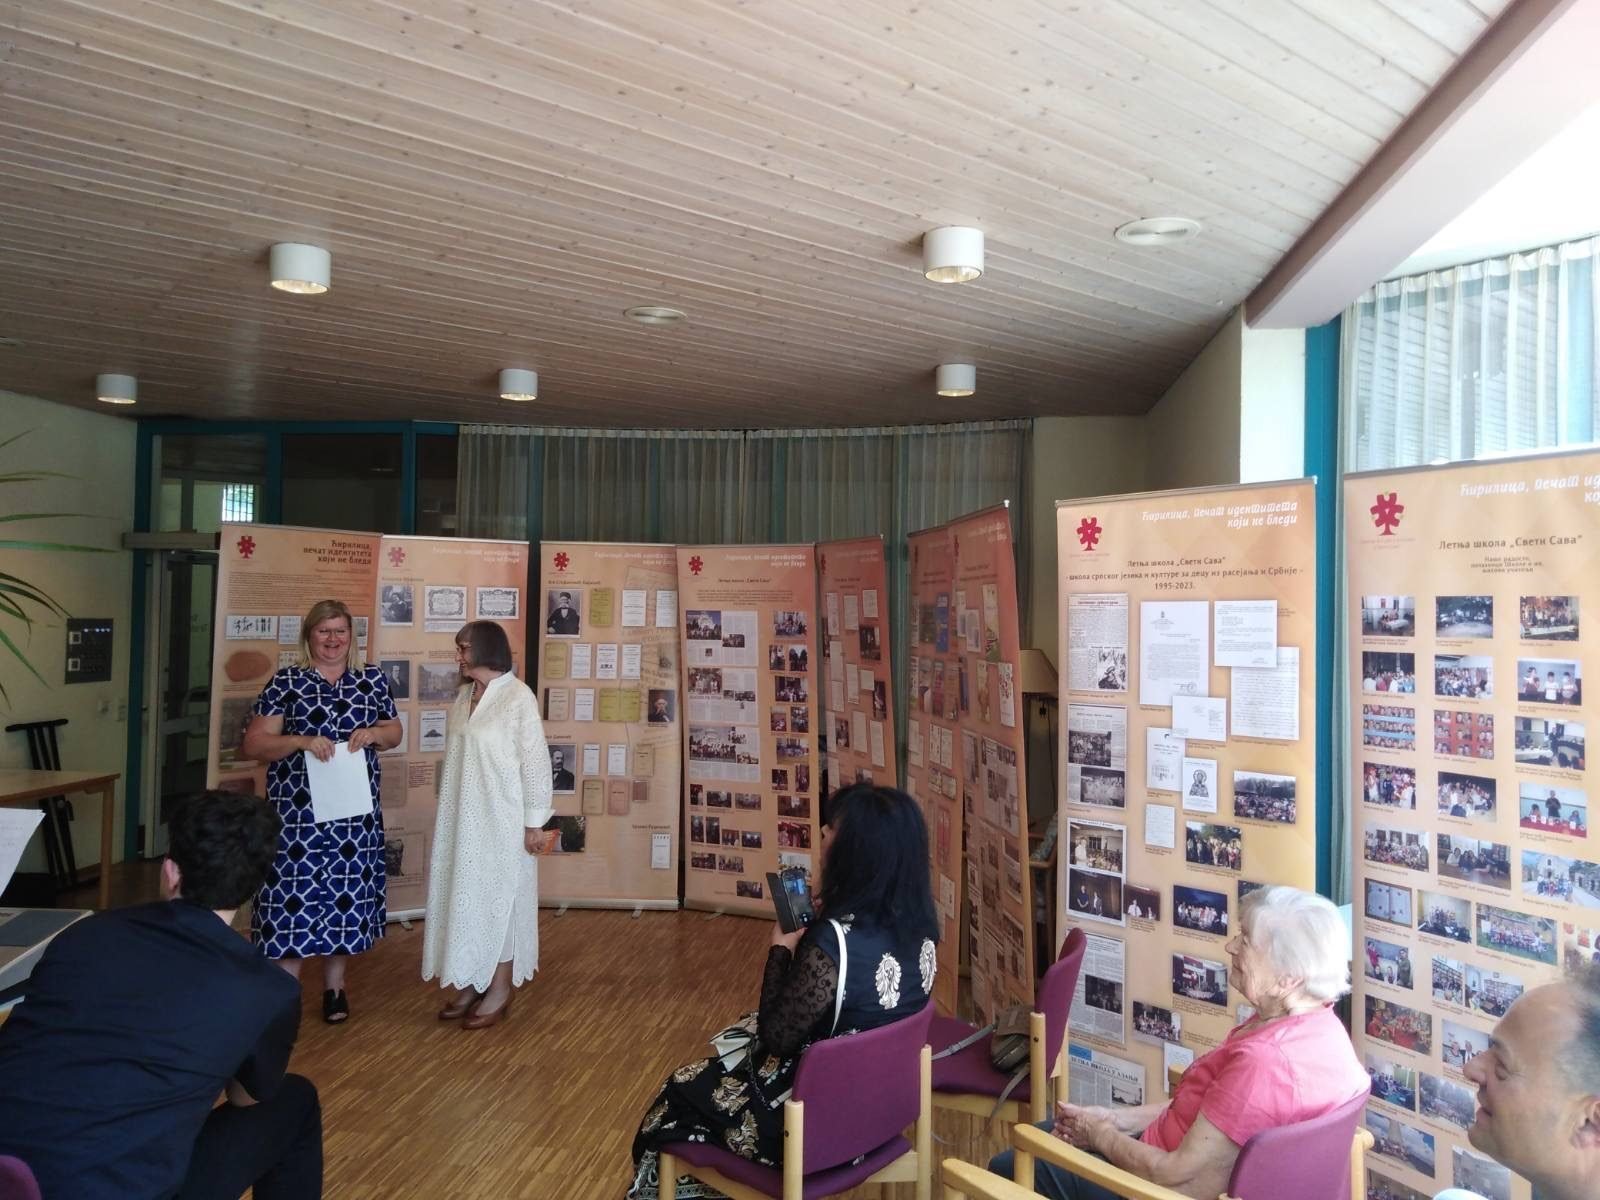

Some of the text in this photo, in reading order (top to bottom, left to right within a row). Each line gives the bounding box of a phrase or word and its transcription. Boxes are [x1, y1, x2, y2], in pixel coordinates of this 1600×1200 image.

[1439, 541, 1471, 551] Летња
[1474, 539, 1506, 549] школа
[1127, 560, 1149, 568] Летња
[1151, 572, 1179, 580] културе
[1222, 568, 1259, 579] расејања
[1268, 566, 1298, 577] Србије
